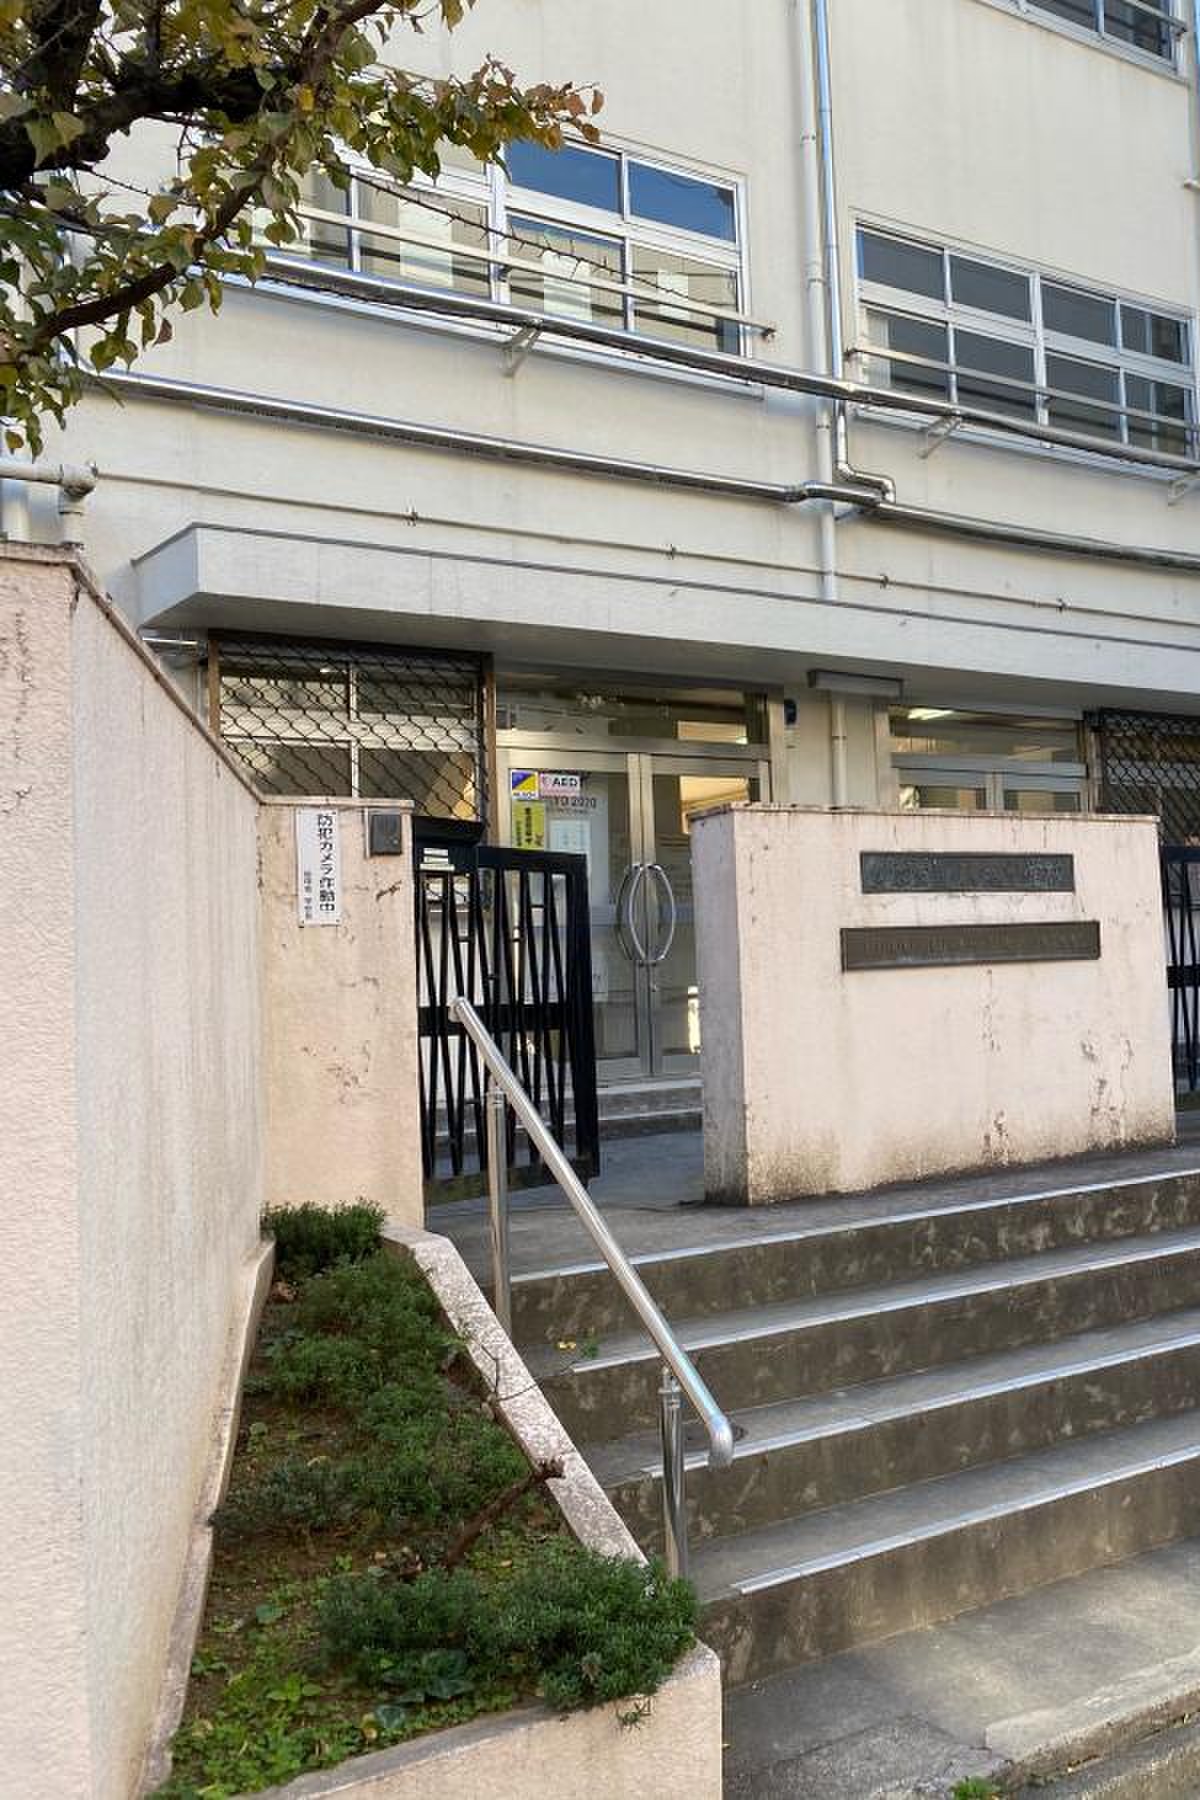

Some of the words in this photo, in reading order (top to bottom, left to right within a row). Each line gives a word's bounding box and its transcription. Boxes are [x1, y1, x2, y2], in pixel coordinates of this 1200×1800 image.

[552, 776, 578, 787] AED
[317, 813, 335, 912] 防犯カメラ作動中
